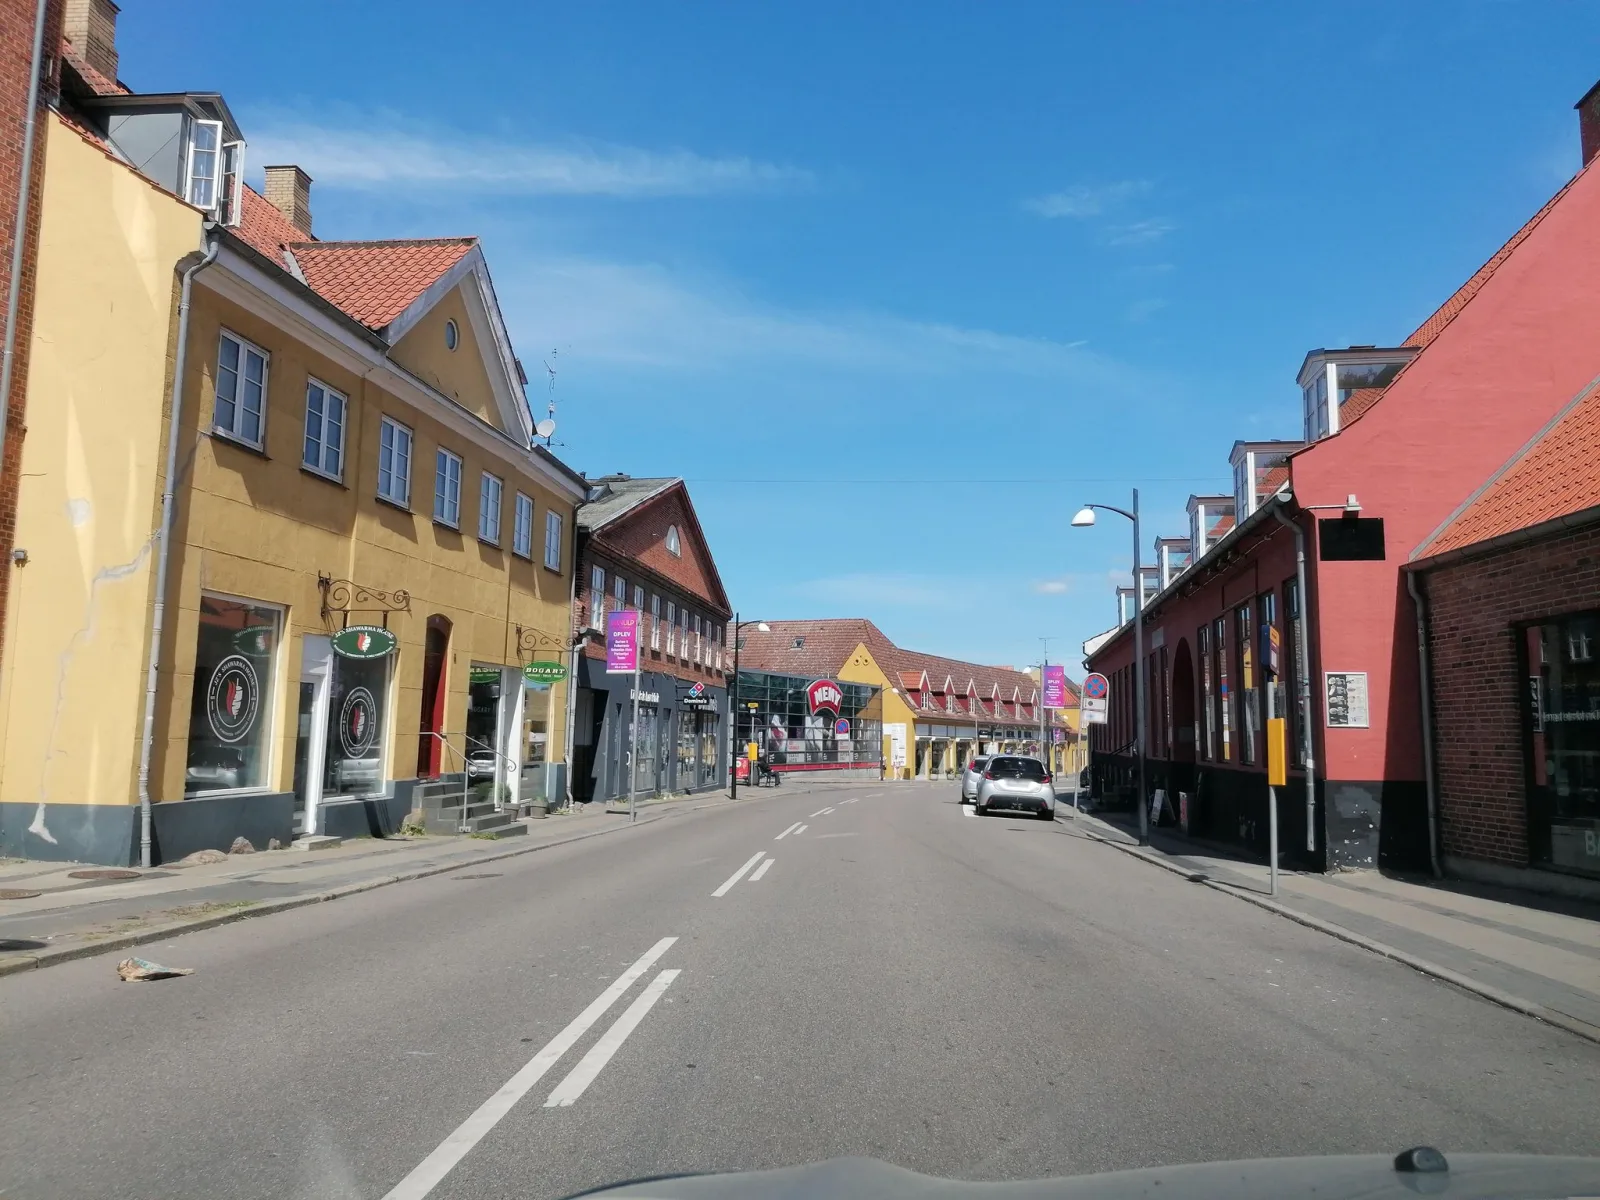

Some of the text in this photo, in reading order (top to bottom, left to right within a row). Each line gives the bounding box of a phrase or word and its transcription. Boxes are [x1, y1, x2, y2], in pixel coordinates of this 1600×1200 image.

[377, 628, 394, 639] HOUSE
[222, 660, 246, 672] SHAWARMA
[245, 666, 255, 686] HOUSE
[814, 686, 841, 706] MENY
